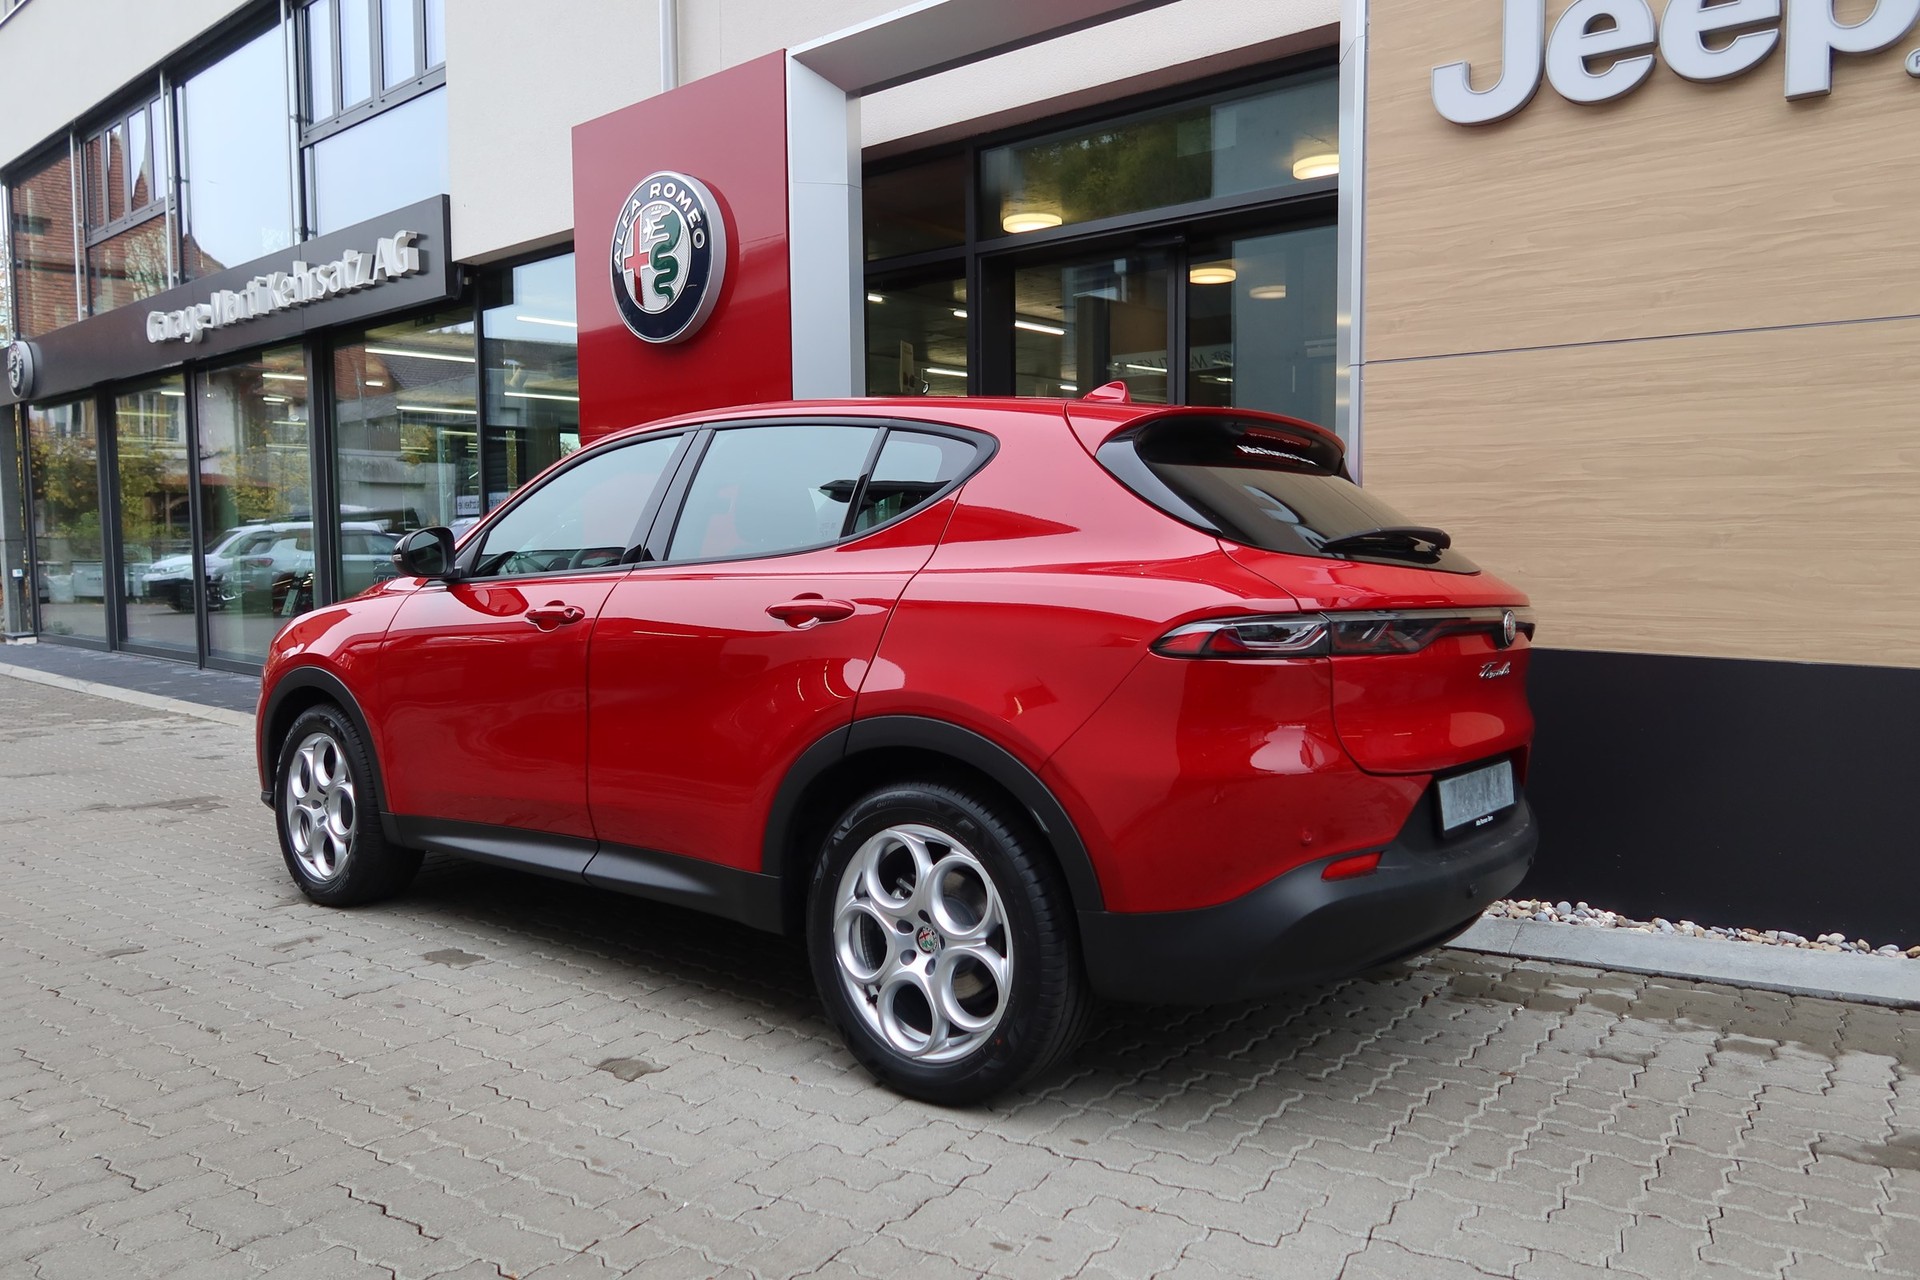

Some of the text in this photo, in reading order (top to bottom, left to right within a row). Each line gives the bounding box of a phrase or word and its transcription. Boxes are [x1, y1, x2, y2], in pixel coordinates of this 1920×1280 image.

[1431, 0, 1920, 126] Jeep
[614, 182, 706, 267] ALFA ROMEO
[146, 230, 420, 343] Garage Marti Kehrsatz AG
